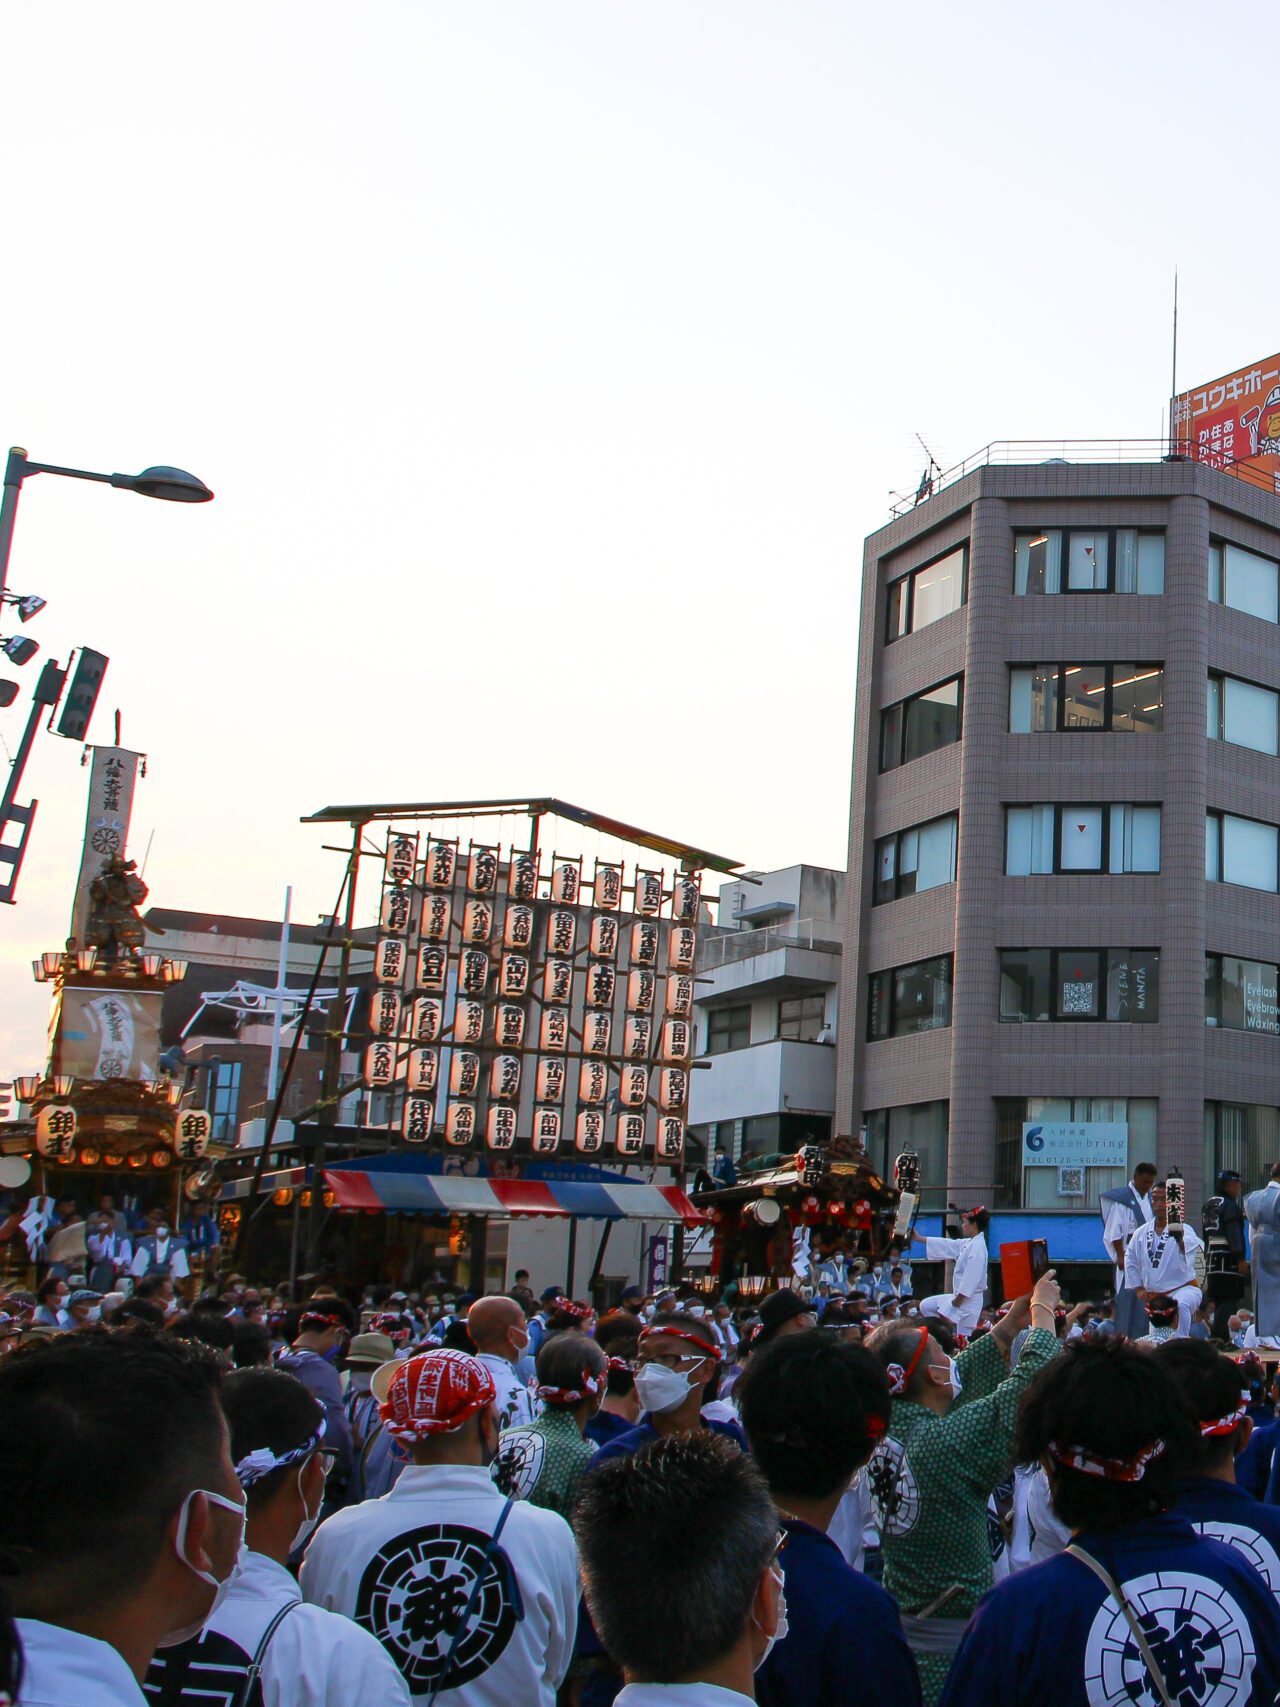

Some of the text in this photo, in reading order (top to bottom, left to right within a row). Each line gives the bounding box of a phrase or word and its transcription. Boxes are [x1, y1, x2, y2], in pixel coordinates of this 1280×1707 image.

[1247, 982, 1278, 998] Eyelash
[1247, 999, 1280, 1015] Eyebrow
[1246, 1015, 1280, 1034] Waxing
